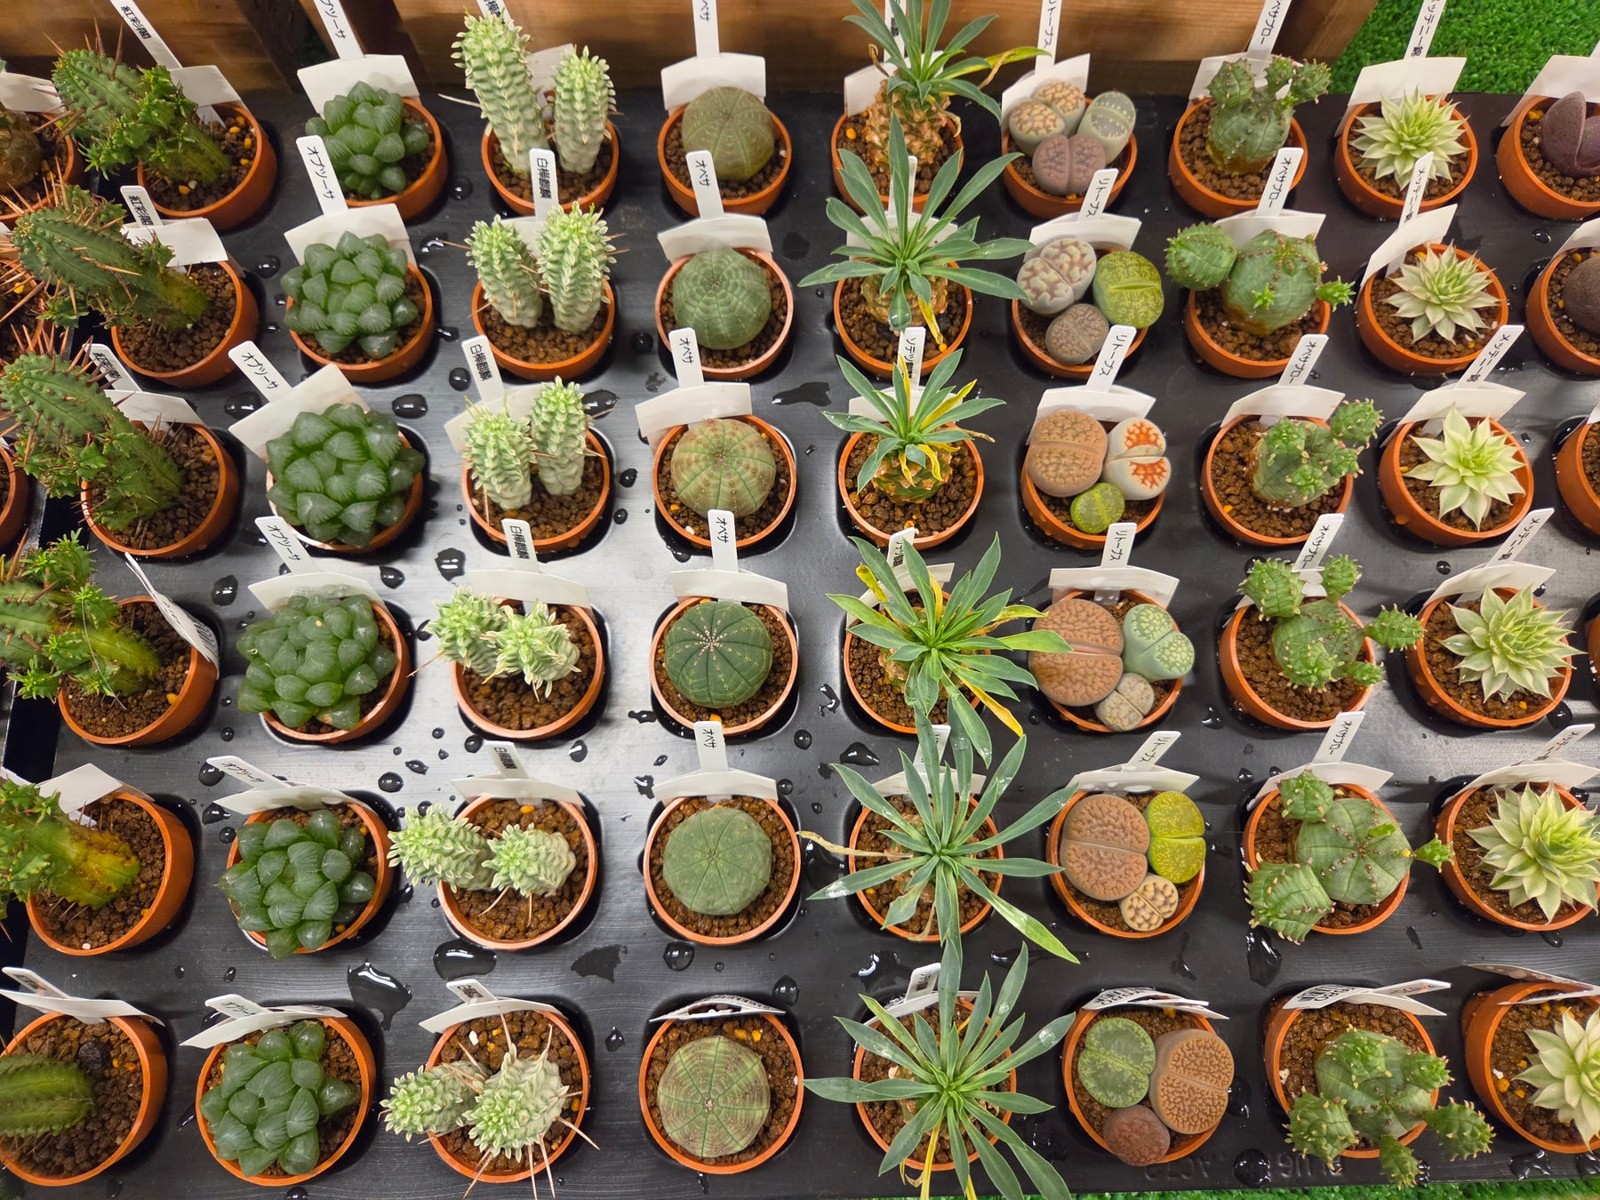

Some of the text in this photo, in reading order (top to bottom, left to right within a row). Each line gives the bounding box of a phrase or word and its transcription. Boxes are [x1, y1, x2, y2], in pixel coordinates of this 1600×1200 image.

[696, 160, 710, 186] オベサ
[1086, 179, 1109, 217] リトープス
[679, 337, 693, 364] オベサ
[1099, 335, 1127, 375] リトープス
[716, 517, 728, 543] オベサ
[1110, 531, 1127, 560] リトープス
[702, 729, 716, 748] オベサ
